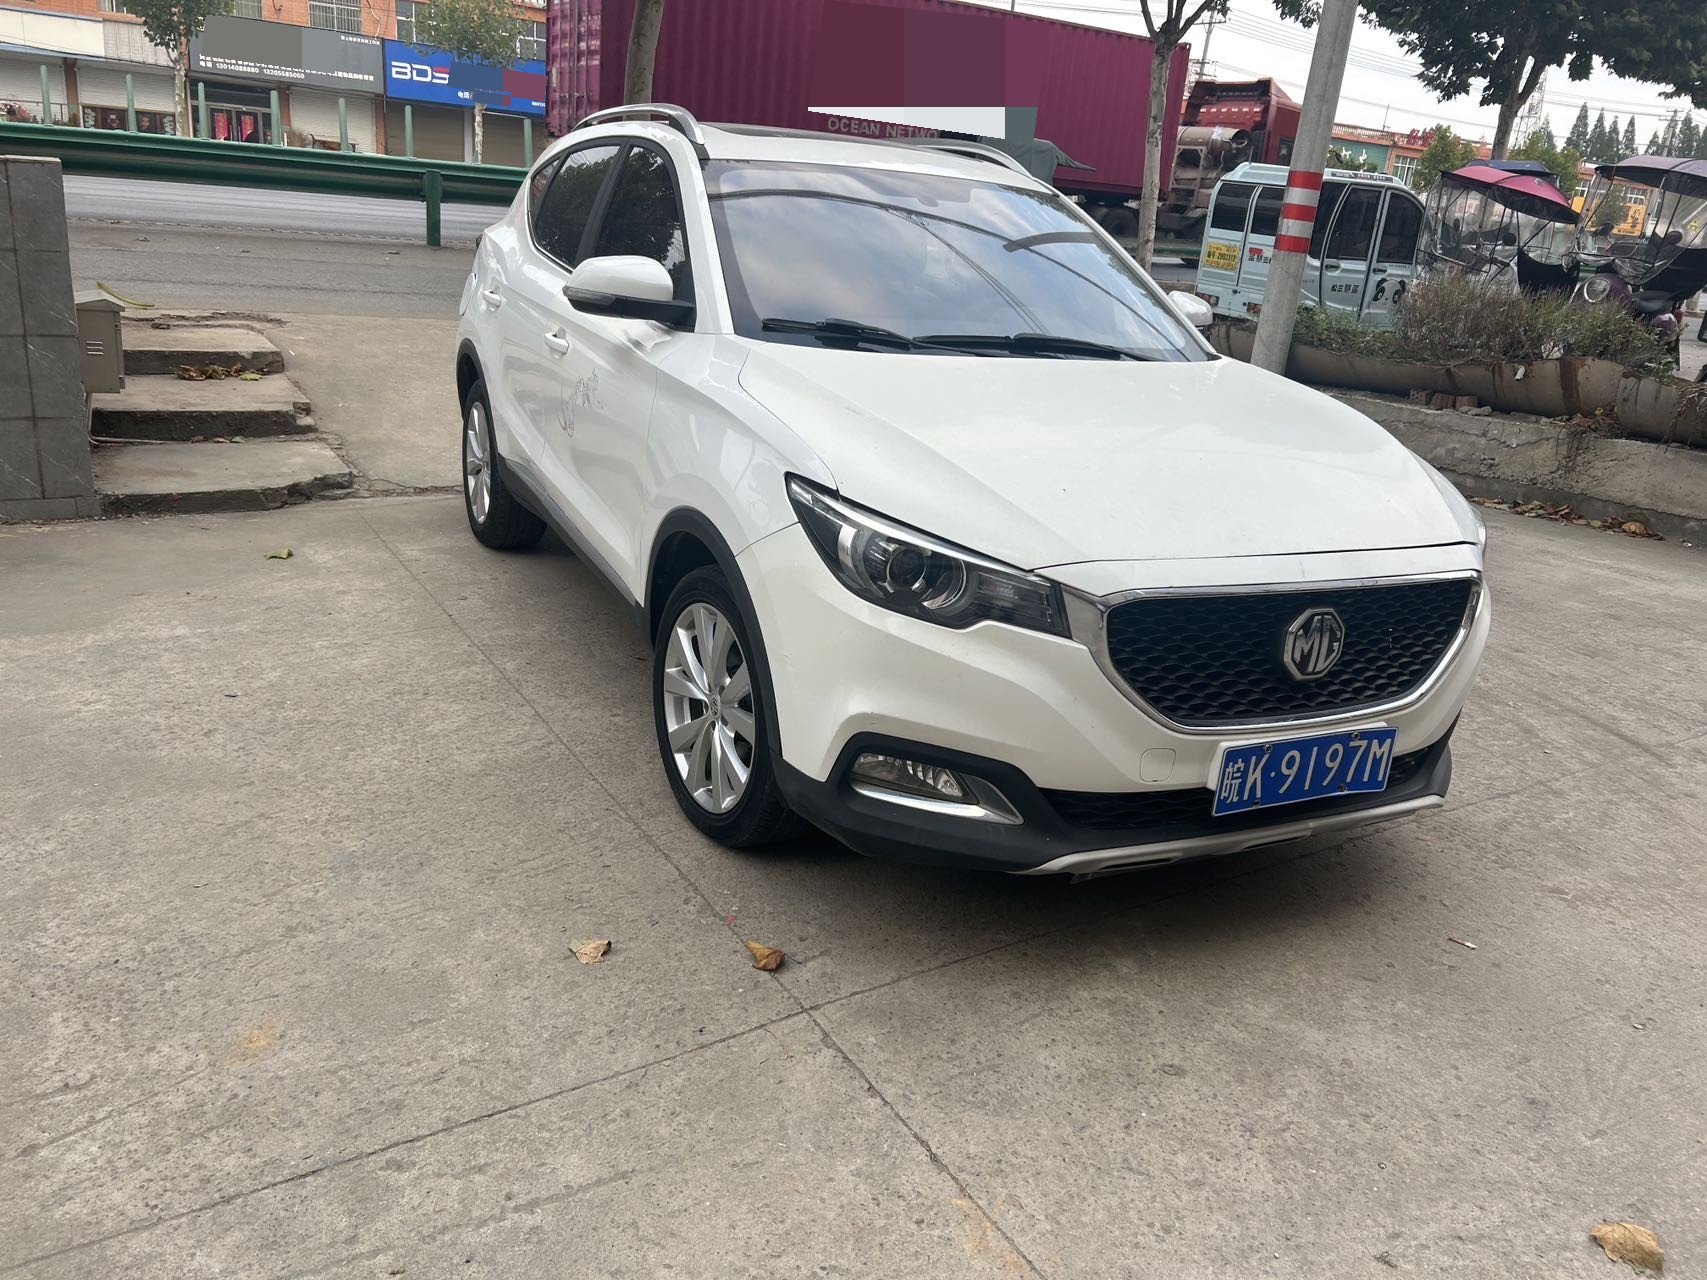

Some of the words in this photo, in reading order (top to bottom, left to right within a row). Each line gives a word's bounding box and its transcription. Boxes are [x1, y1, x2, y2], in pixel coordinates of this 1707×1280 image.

[391, 61, 450, 85] BDS
[827, 116, 880, 136] OCEAN
[1294, 614, 1341, 673] MG
[1220, 738, 1392, 804] 皖K·9197M
